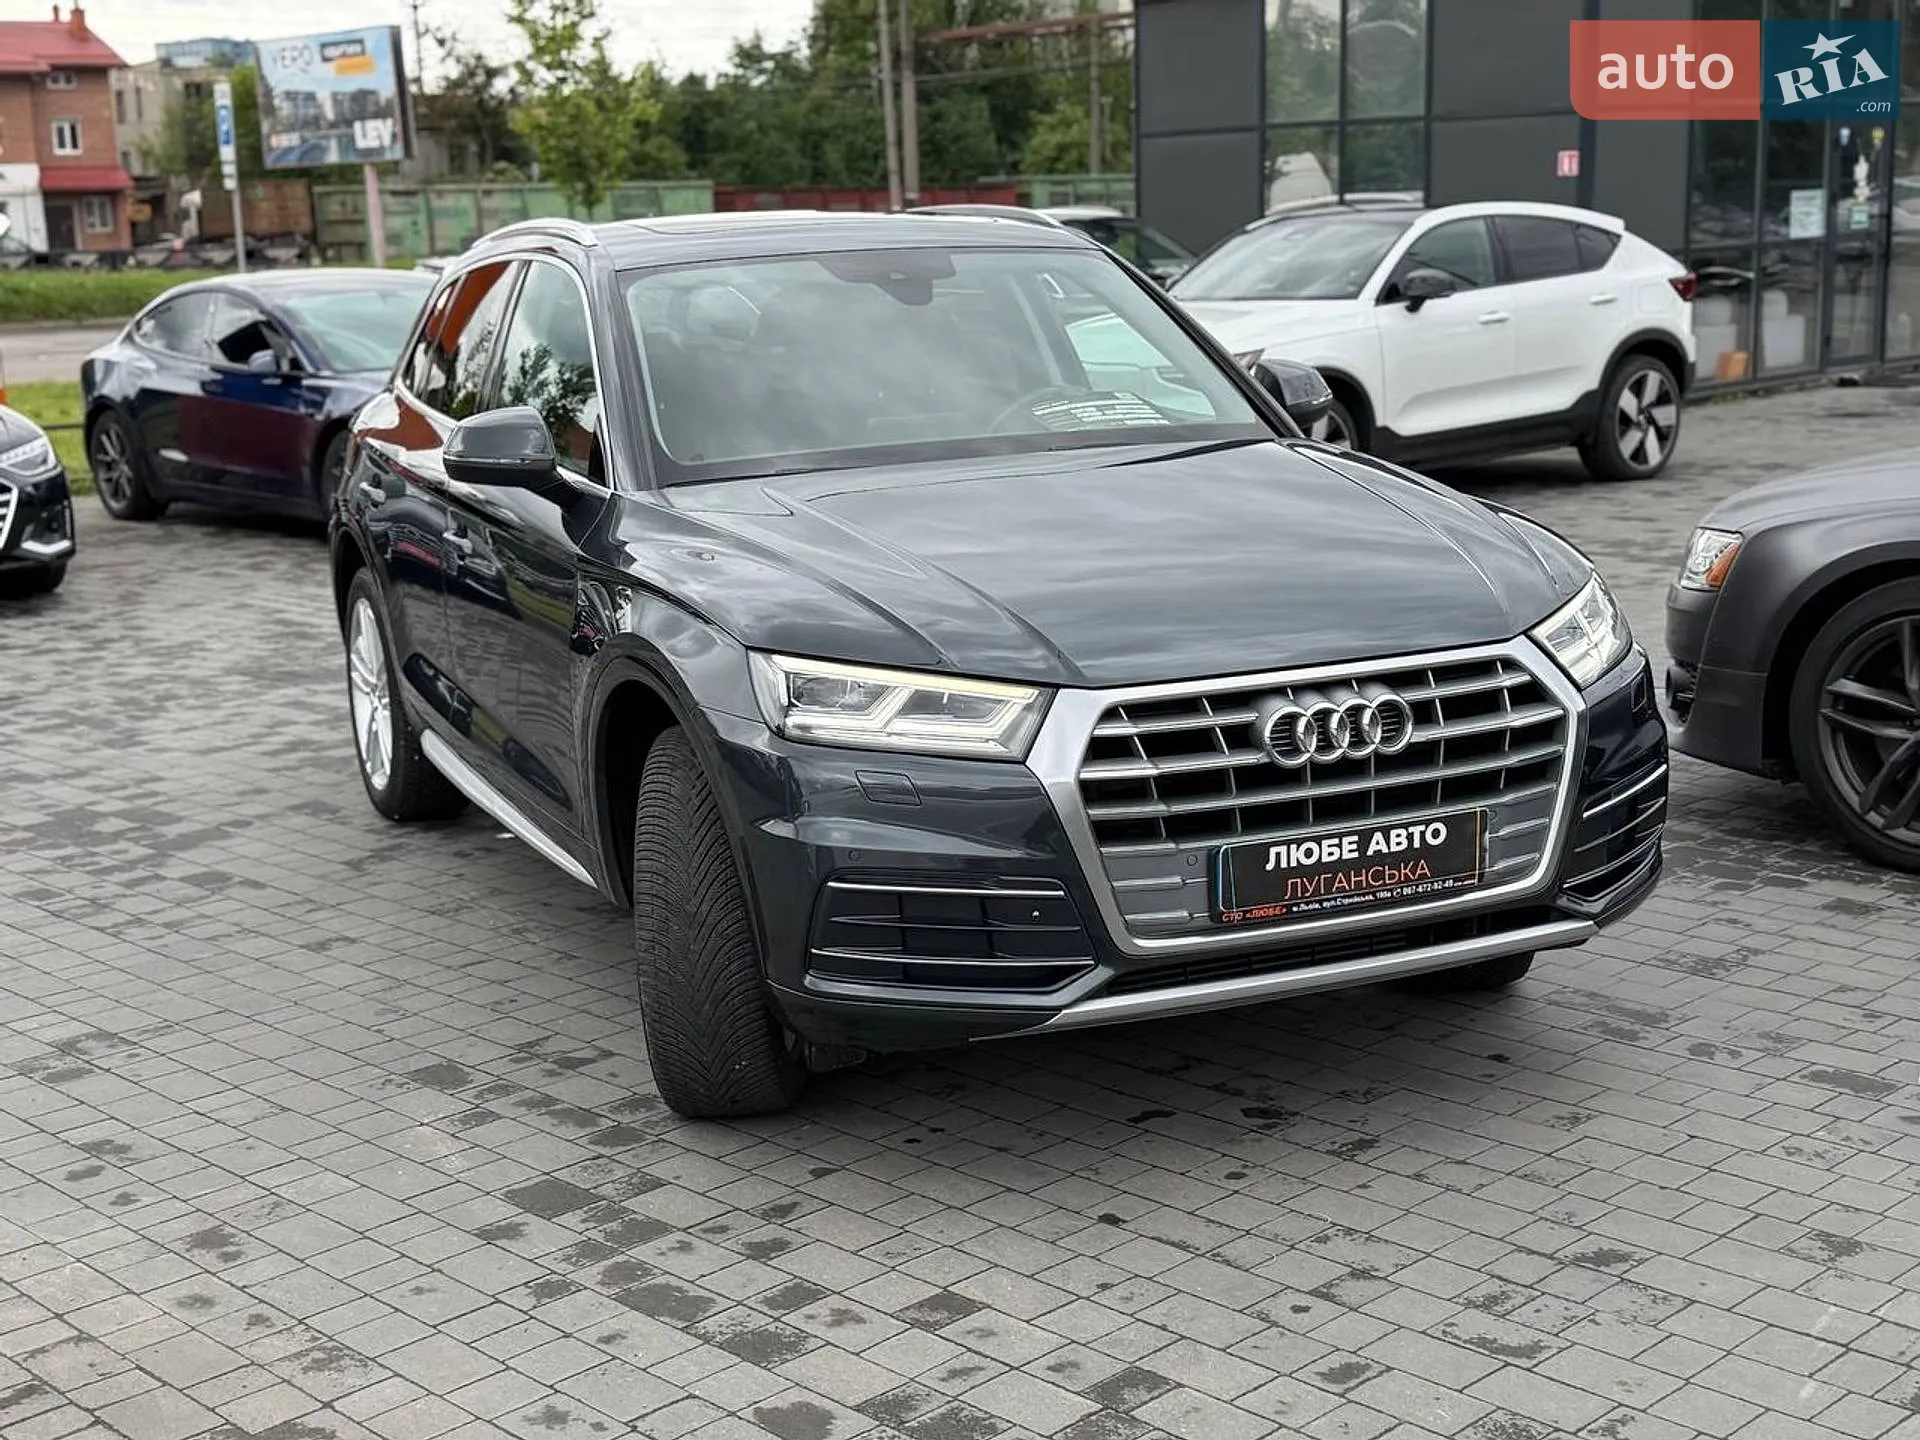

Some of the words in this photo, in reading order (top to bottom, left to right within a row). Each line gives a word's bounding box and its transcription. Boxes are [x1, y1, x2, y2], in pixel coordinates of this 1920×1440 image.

[1265, 835, 1360, 871] ЛЮБЕ
[1366, 822, 1448, 857] АВТО
[1284, 859, 1431, 900] ЛУГАНСЬКА
